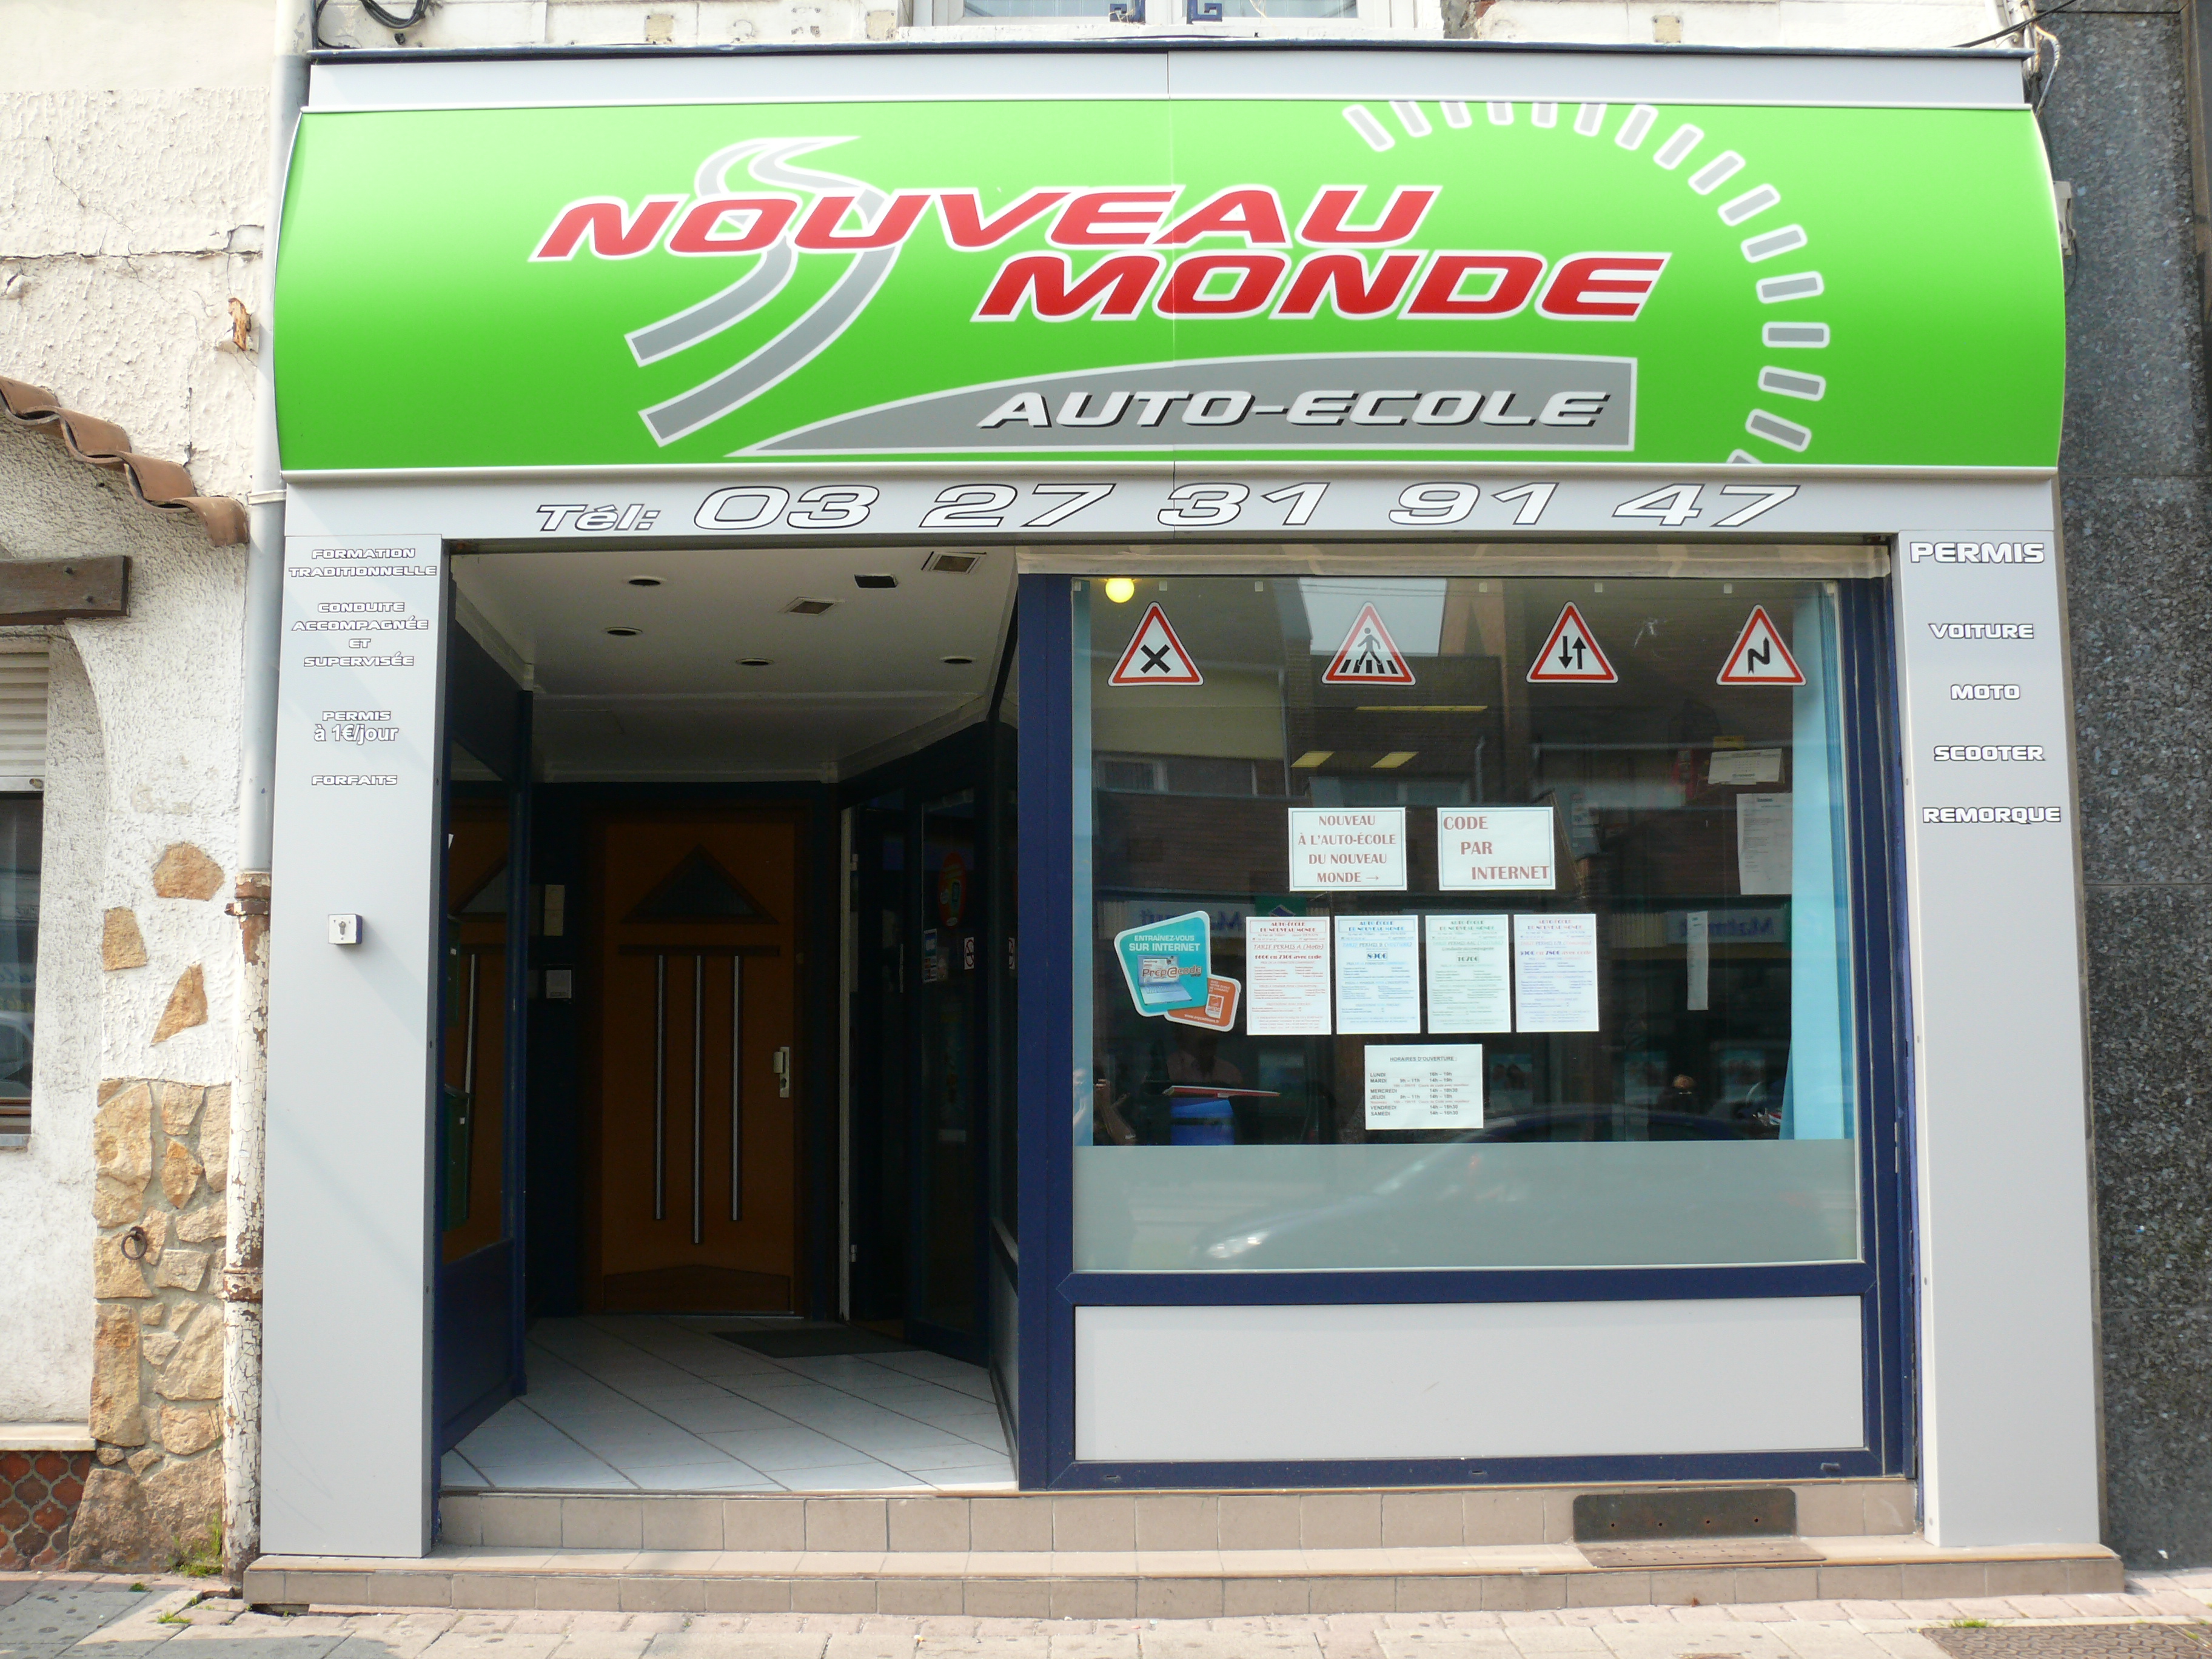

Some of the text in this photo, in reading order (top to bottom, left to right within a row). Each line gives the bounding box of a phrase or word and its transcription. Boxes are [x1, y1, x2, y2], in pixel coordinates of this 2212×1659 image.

[528, 184, 1443, 262] NOUVEAU
[971, 249, 1672, 322] MONDE
[976, 390, 1611, 429] AUTO-ECOLE
[536, 482, 1801, 531] Tél: 03 27 31 91 47
[312, 548, 415, 559] FORMATION
[1910, 541, 2044, 563] PERMIS
[289, 566, 437, 577] TRADITIONNELLE
[318, 602, 404, 612] CONDUITE
[291, 615, 428, 631] ACCOMPAGNÉE
[1928, 623, 2034, 639] VOITURE
[349, 638, 370, 648] ET
[304, 651, 414, 666] SUPERVISÉE
[1951, 684, 2020, 700] MOTO
[323, 711, 391, 720] PERMIS
[313, 724, 399, 745] à 1€/jour
[1934, 746, 2046, 761] SCOOTER
[312, 776, 397, 785] FORFAITS
[1319, 816, 1375, 826] NOUVEAU
[1923, 806, 2061, 824] REMORQUE
[1444, 816, 1488, 830] CODE
[1298, 832, 1396, 845] À L'AUTO-ÉCOLE
[1461, 842, 1492, 855] PAR
[1309, 854, 1387, 864] DU NOUVEAU
[1317, 873, 1362, 882] MONDE
[1472, 866, 1549, 880] INTERNET
[1129, 943, 1201, 951] SUR INTERNET
